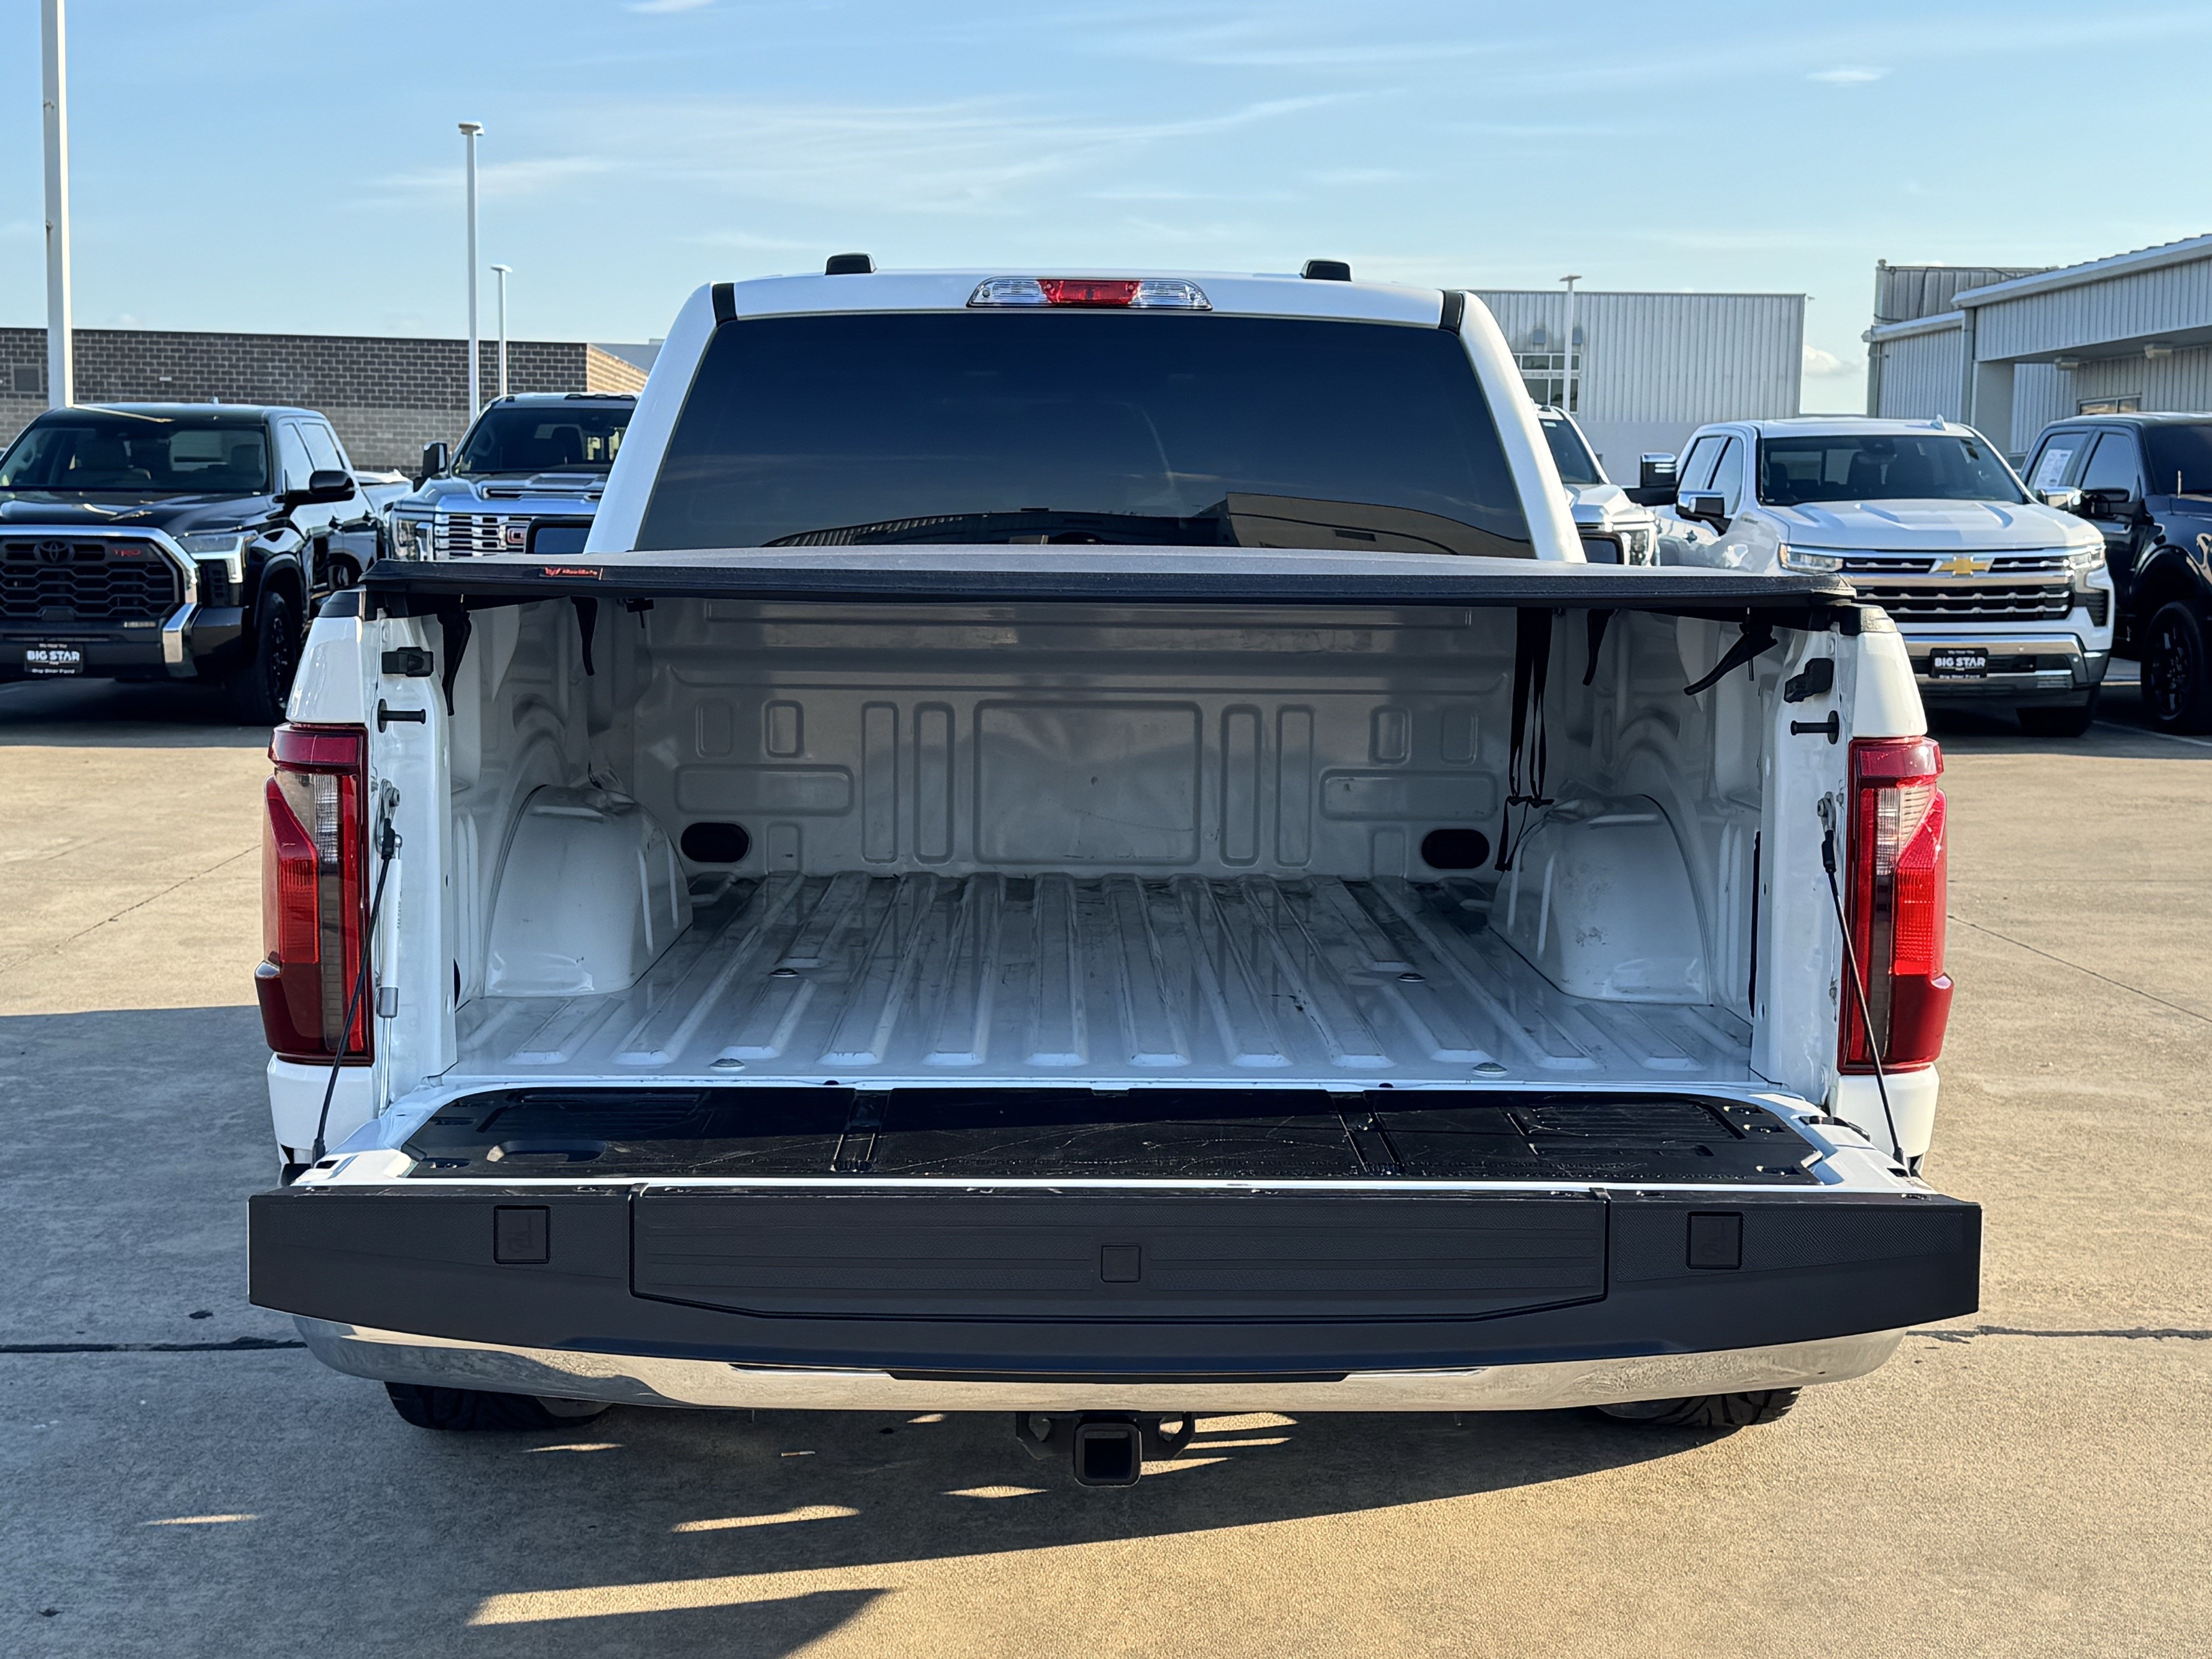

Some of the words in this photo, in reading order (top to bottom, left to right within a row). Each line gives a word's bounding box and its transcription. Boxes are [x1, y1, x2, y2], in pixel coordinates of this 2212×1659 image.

[27, 650, 48, 661] BIG
[49, 650, 80, 661] STAR
[1934, 657, 1954, 667] BIG
[1956, 657, 1985, 667] STAR
